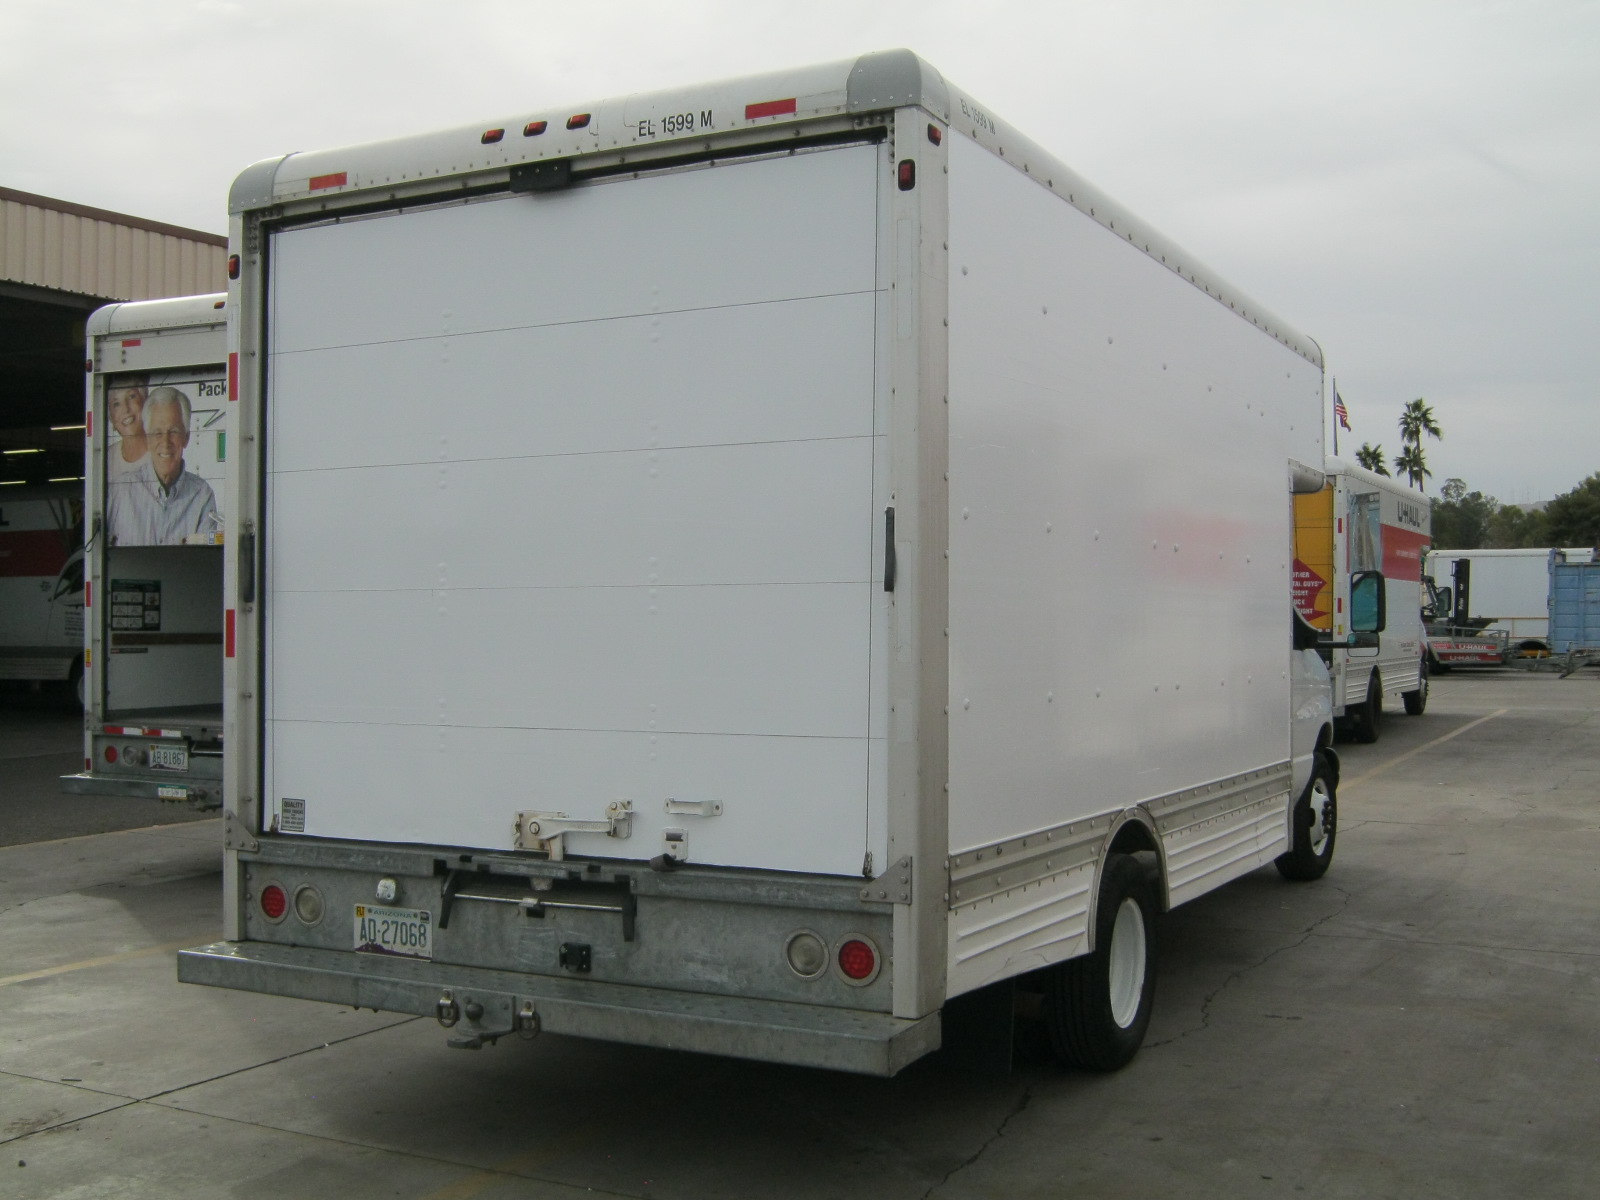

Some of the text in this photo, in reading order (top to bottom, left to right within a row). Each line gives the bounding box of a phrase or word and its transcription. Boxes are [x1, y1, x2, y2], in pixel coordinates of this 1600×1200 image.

[639, 109, 712, 137] EL 1599 M
[960, 98, 970, 118] EL
[971, 106, 987, 129] 1599
[284, 801, 303, 809] QUALITY
[373, 909, 413, 919] ARIZONA
